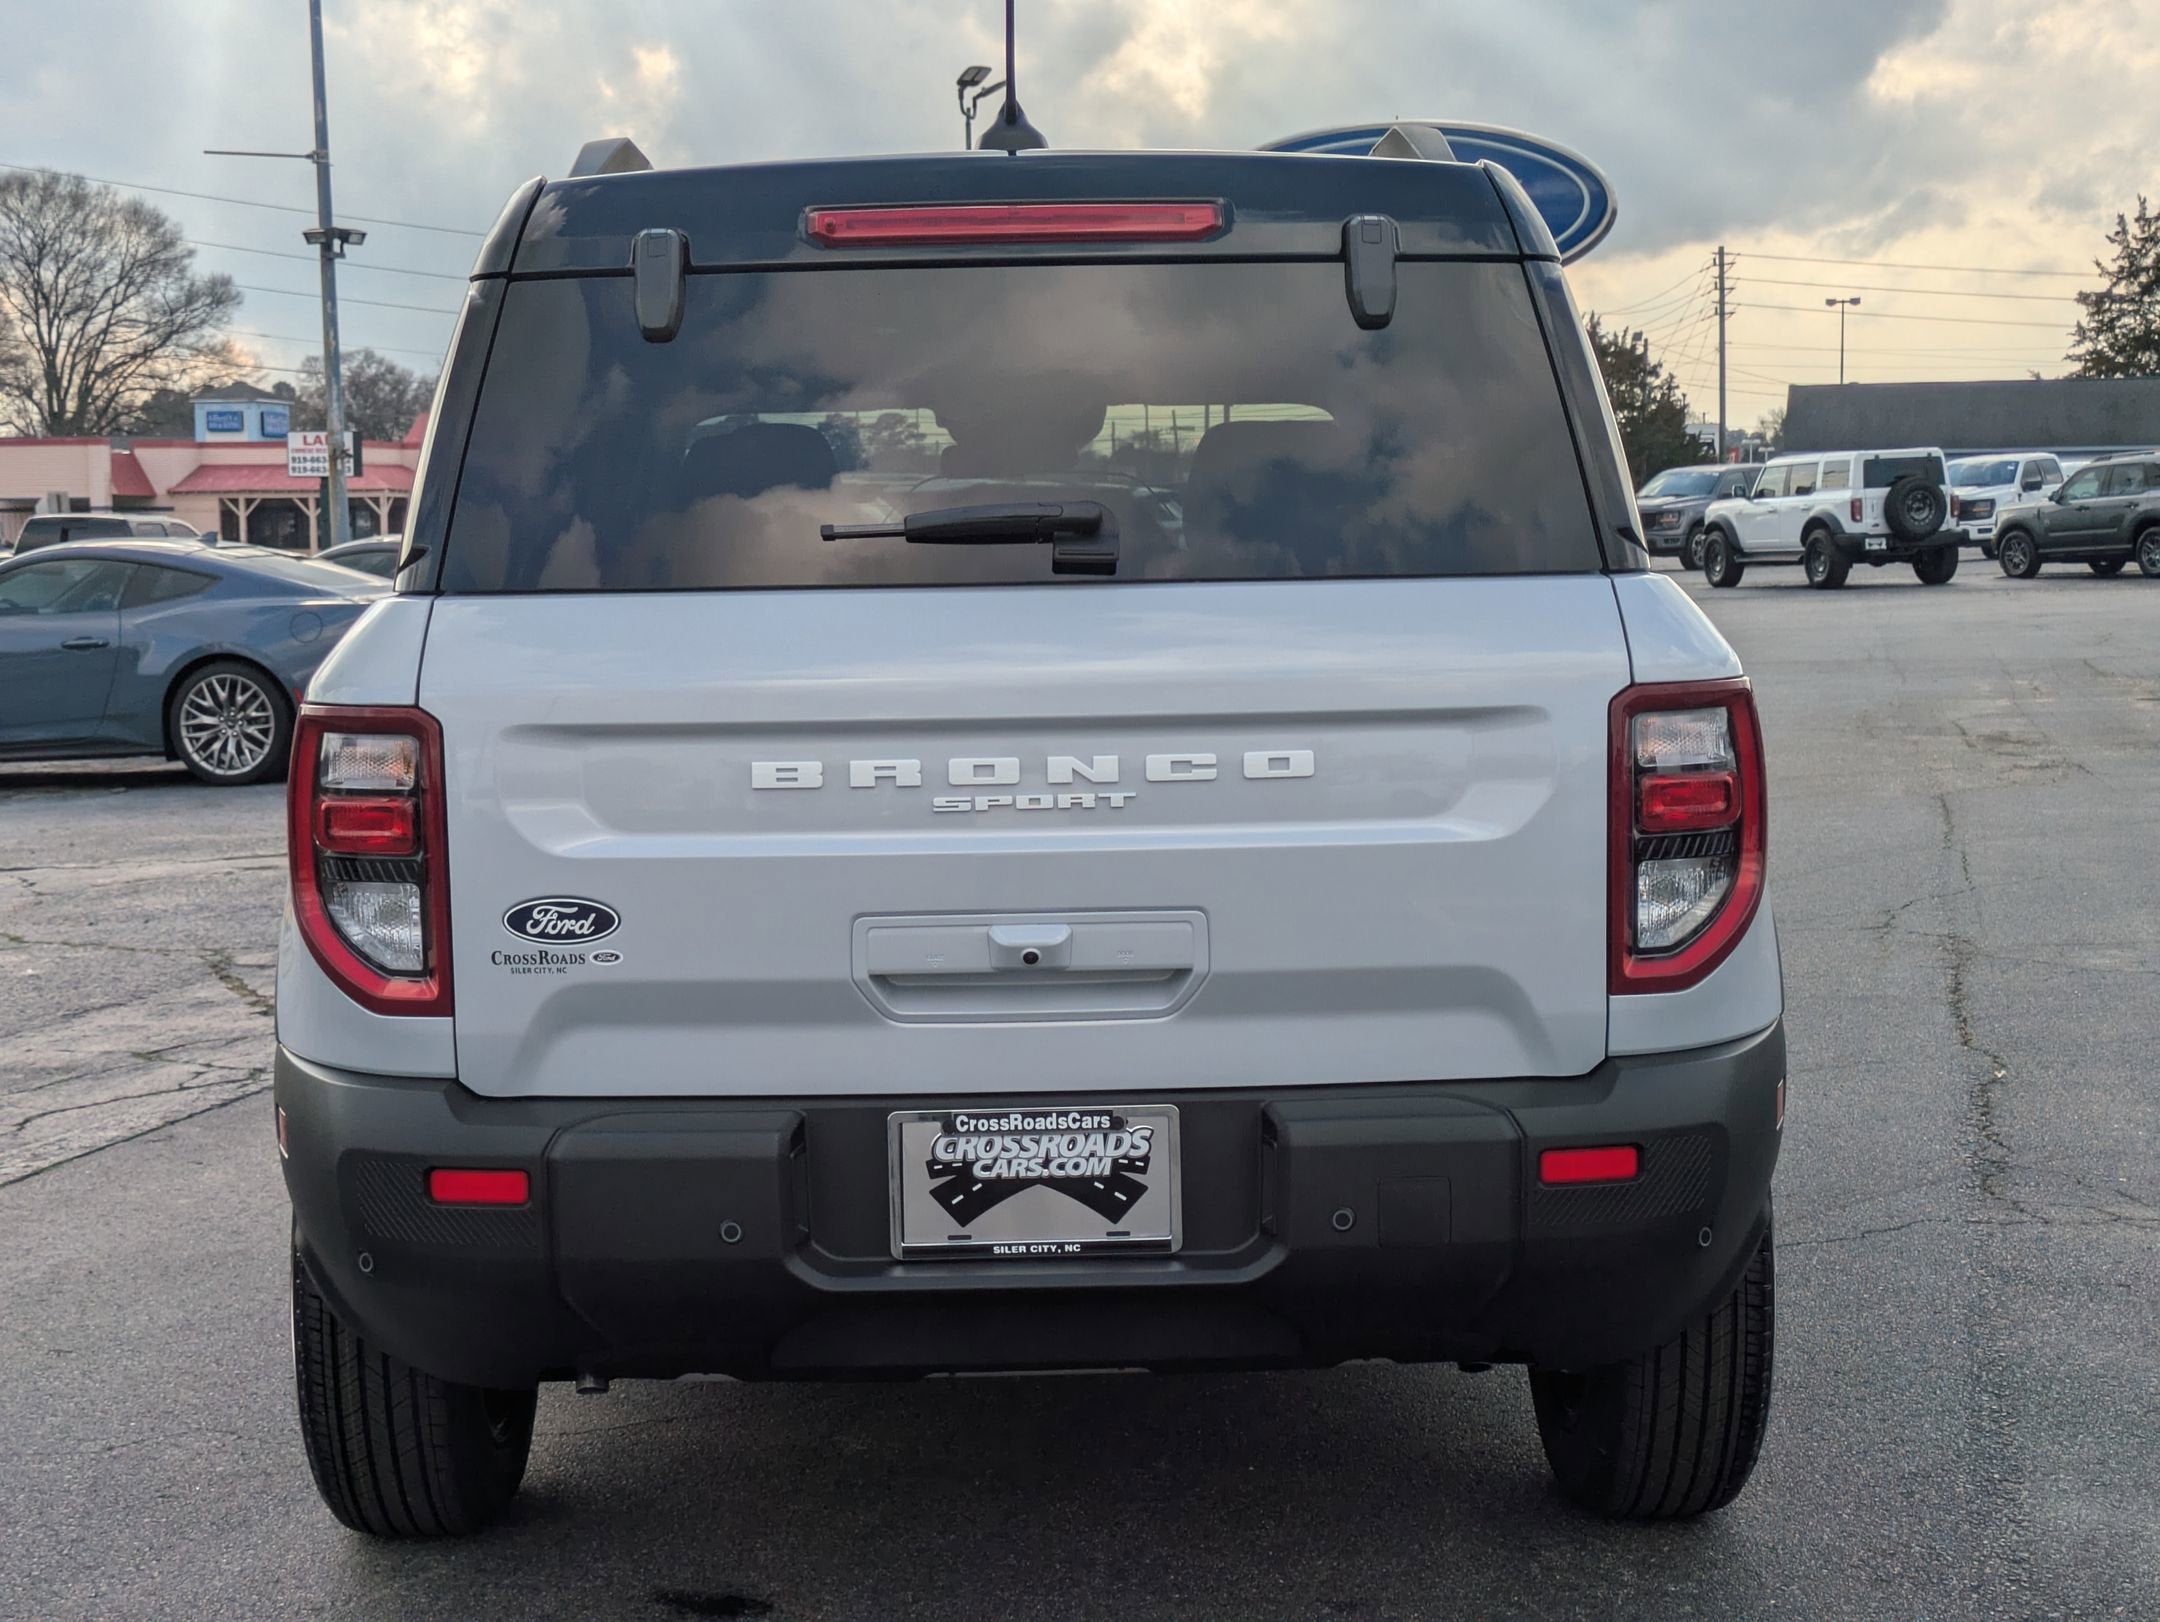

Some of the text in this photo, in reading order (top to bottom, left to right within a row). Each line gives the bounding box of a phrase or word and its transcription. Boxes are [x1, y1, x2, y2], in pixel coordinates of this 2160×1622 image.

[303, 435, 331, 446] LA
[752, 750, 1315, 789] BRONCO
[932, 792, 1136, 812] SPORT
[526, 905, 596, 935] Ford
[955, 1112, 1111, 1133] CrossRoadsCars
[933, 1128, 1153, 1162] CROSSROADS
[972, 1158, 1112, 1179] CARS.COM
[993, 1243, 1081, 1254] SILER CITY, NC
